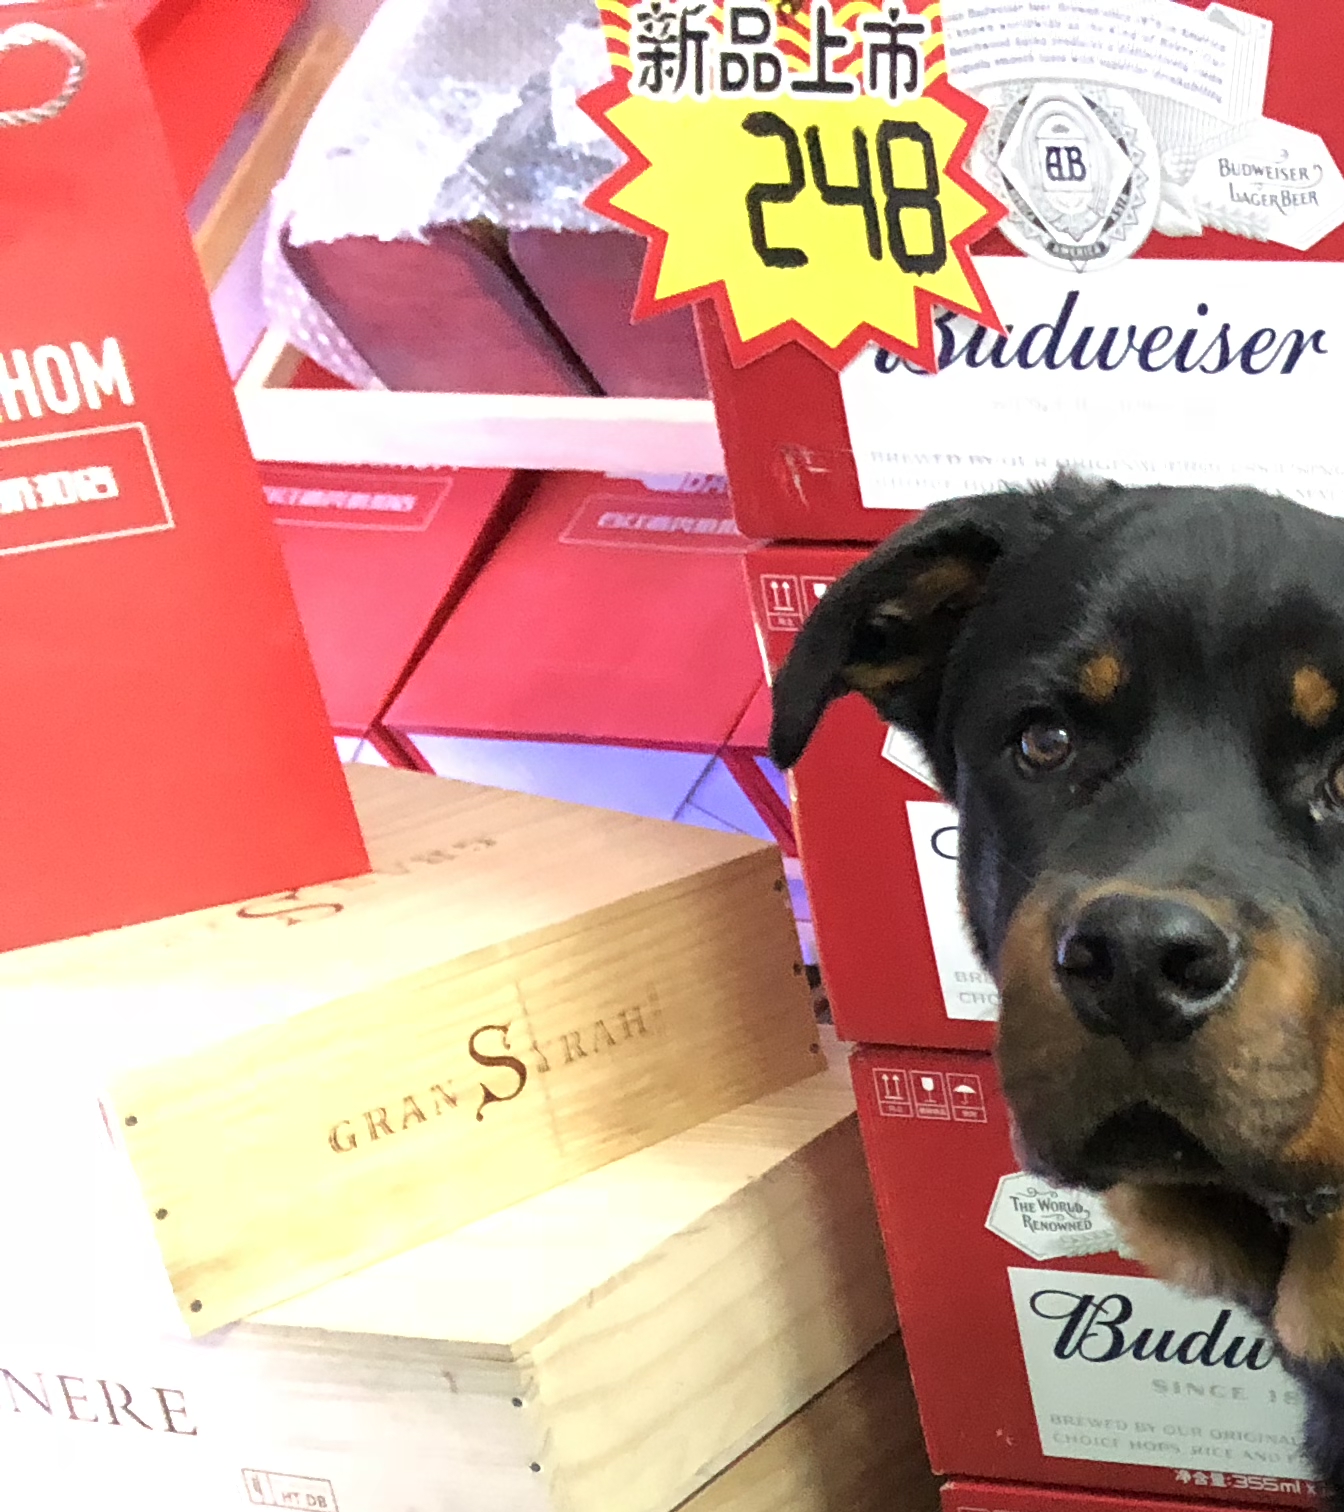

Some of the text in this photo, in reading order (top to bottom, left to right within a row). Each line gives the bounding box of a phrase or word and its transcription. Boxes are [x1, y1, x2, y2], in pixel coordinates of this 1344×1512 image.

[636, 3, 926, 99] 新品上市
[1045, 145, 1087, 182] AB
[1218, 157, 1311, 182] BUDWEISER
[741, 110, 947, 277] 248
[0, 336, 135, 422] HOM
[1009, 1196, 1036, 1213] THE
[1021, 1214, 1093, 1234] RENOWNED
